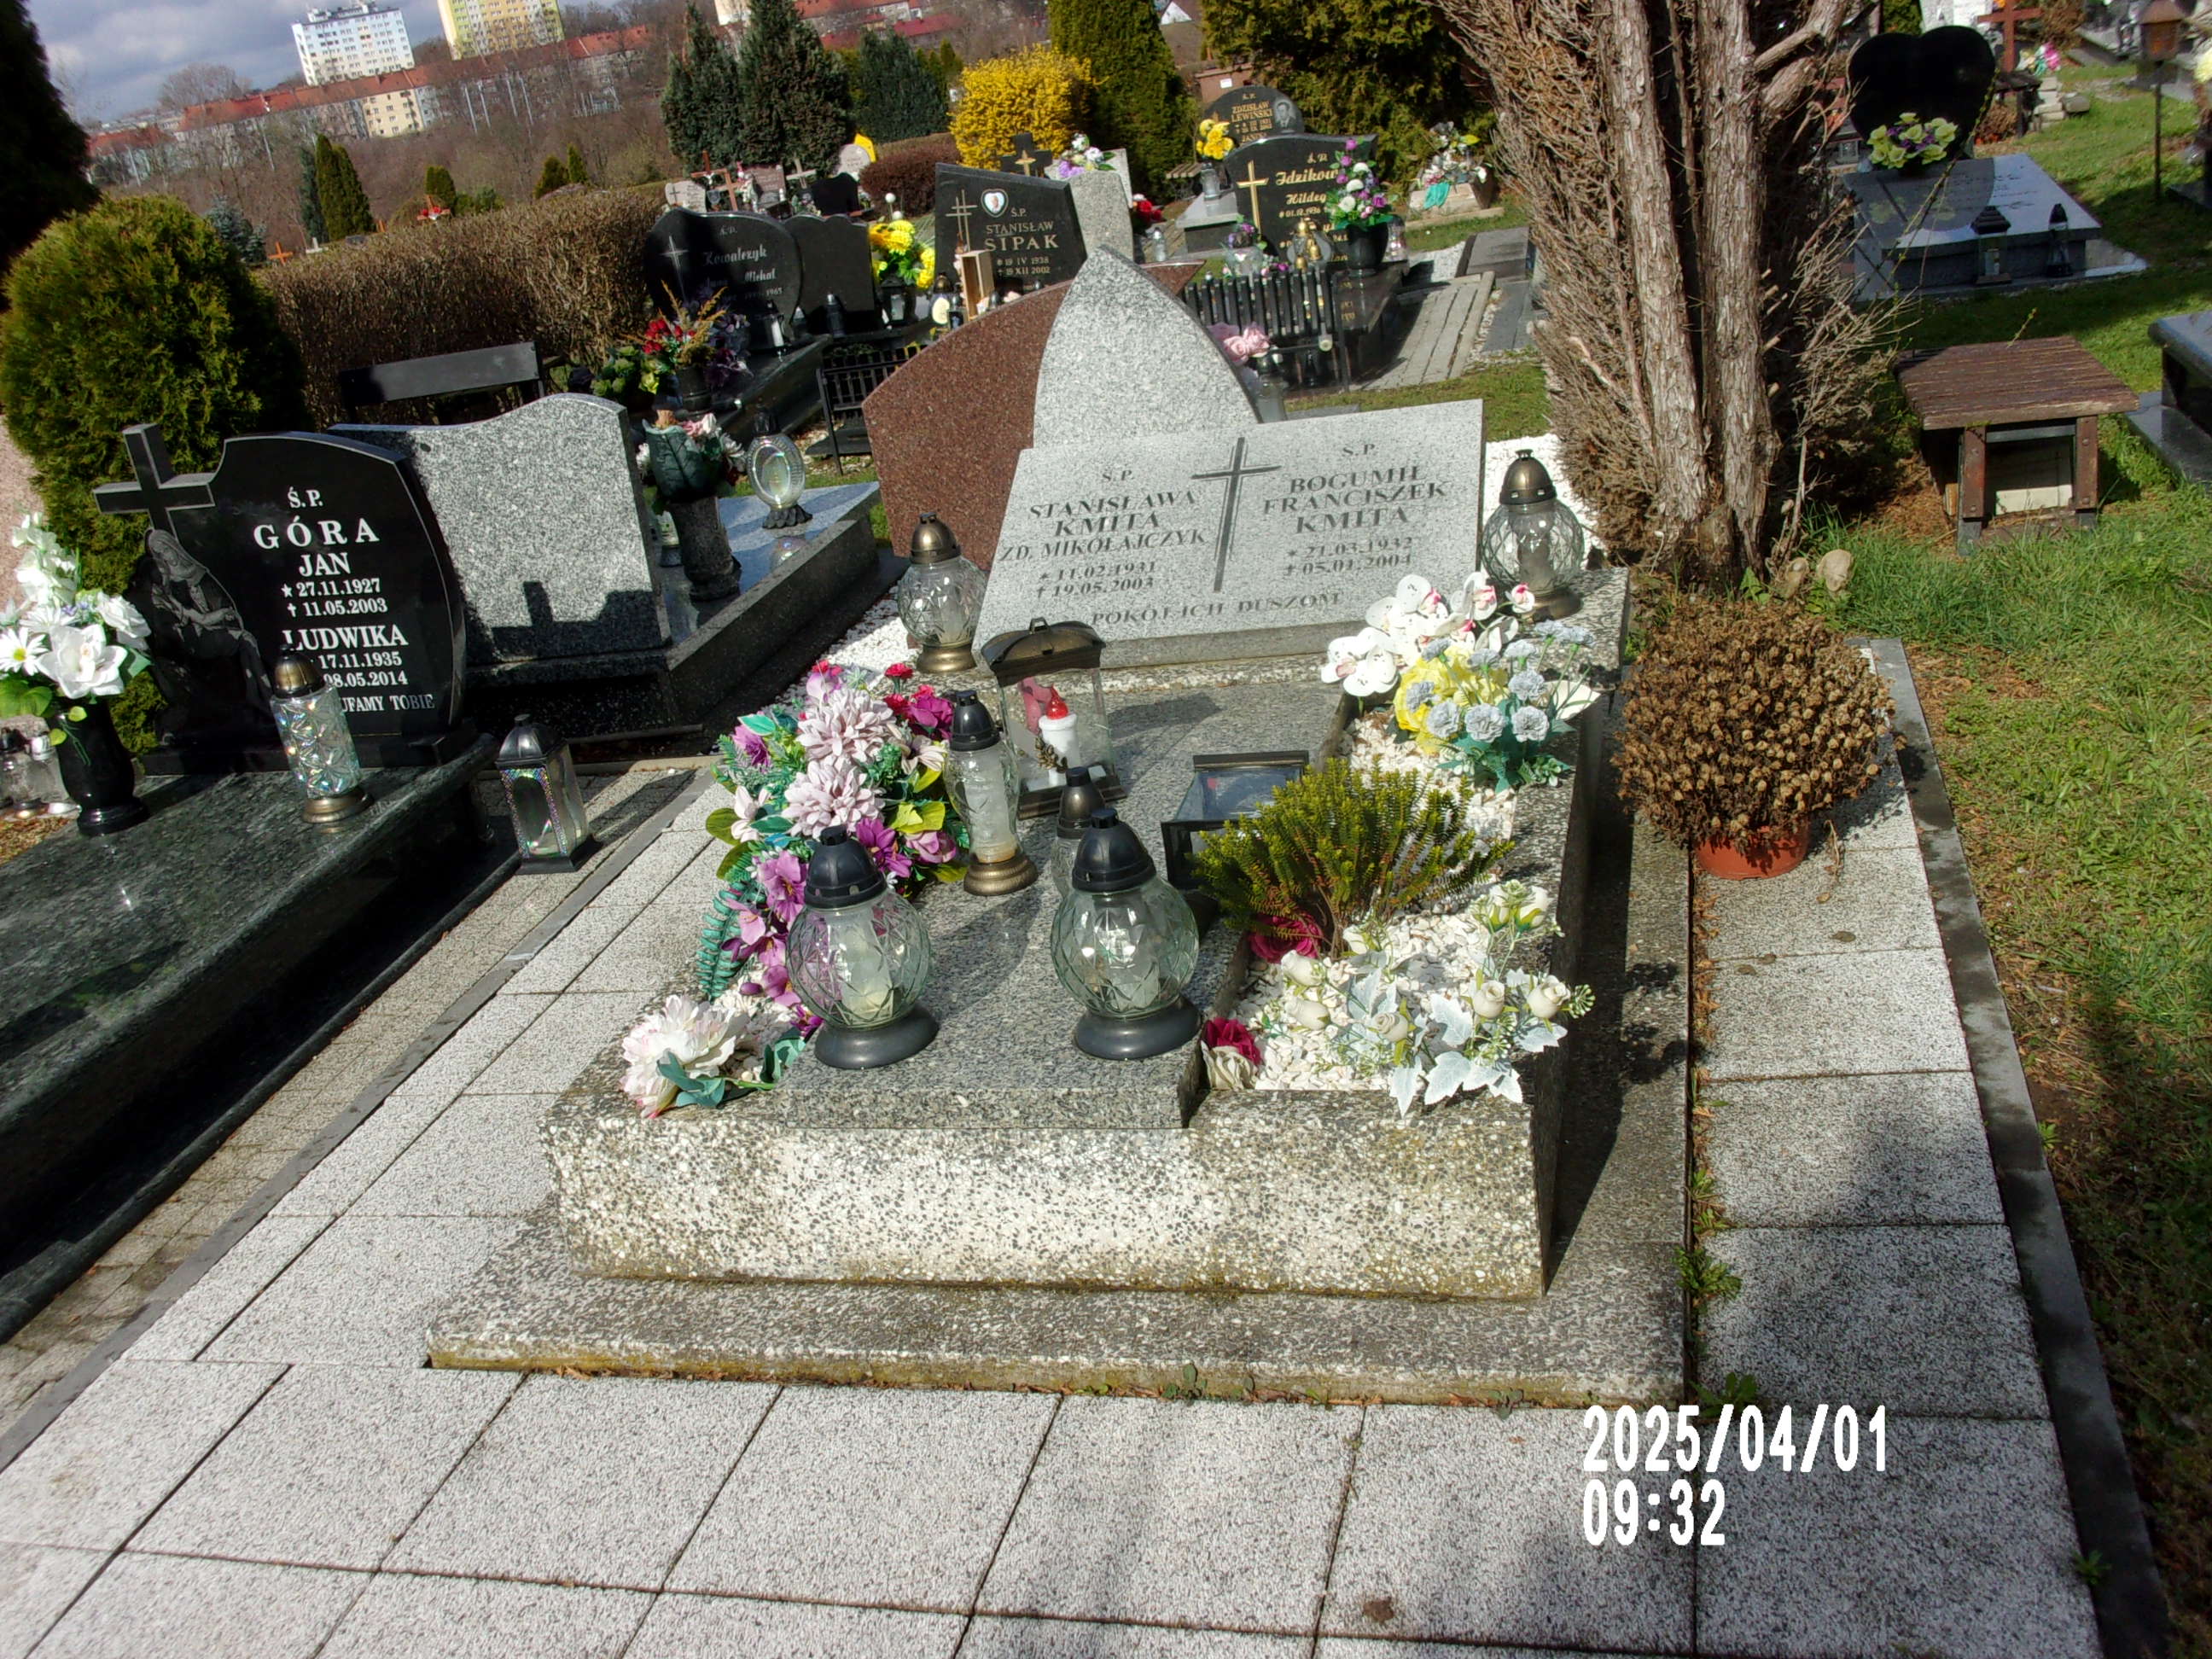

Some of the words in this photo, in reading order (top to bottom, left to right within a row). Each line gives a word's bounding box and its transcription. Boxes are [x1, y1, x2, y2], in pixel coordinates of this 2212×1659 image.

[1285, 193, 1327, 205] Hildeg
[986, 221, 1054, 234] STANISŁAW
[984, 234, 1059, 252] SIPAK
[1029, 490, 1197, 519] STANISŁAWA
[1264, 481, 1452, 514] FRANCISZEK
[1054, 512, 1159, 537] KMITA
[1295, 507, 1408, 534] KMITA
[253, 515, 381, 550] GÓRA
[1040, 529, 1208, 556] MIKOŁAJCZYK
[299, 551, 352, 577] JAN
[1057, 561, 1157, 581] 11.02.1931
[295, 577, 381, 597] 27.11.1927
[1051, 577, 1155, 597] 19.05.2003
[302, 597, 388, 617] 11.05.2003
[1181, 602, 1225, 619] ICH
[282, 624, 410, 651] LUDWIKA
[317, 651, 403, 669] 17.11.1935
[323, 671, 409, 689] 08.05.2014
[389, 694, 435, 712] TOBIE
